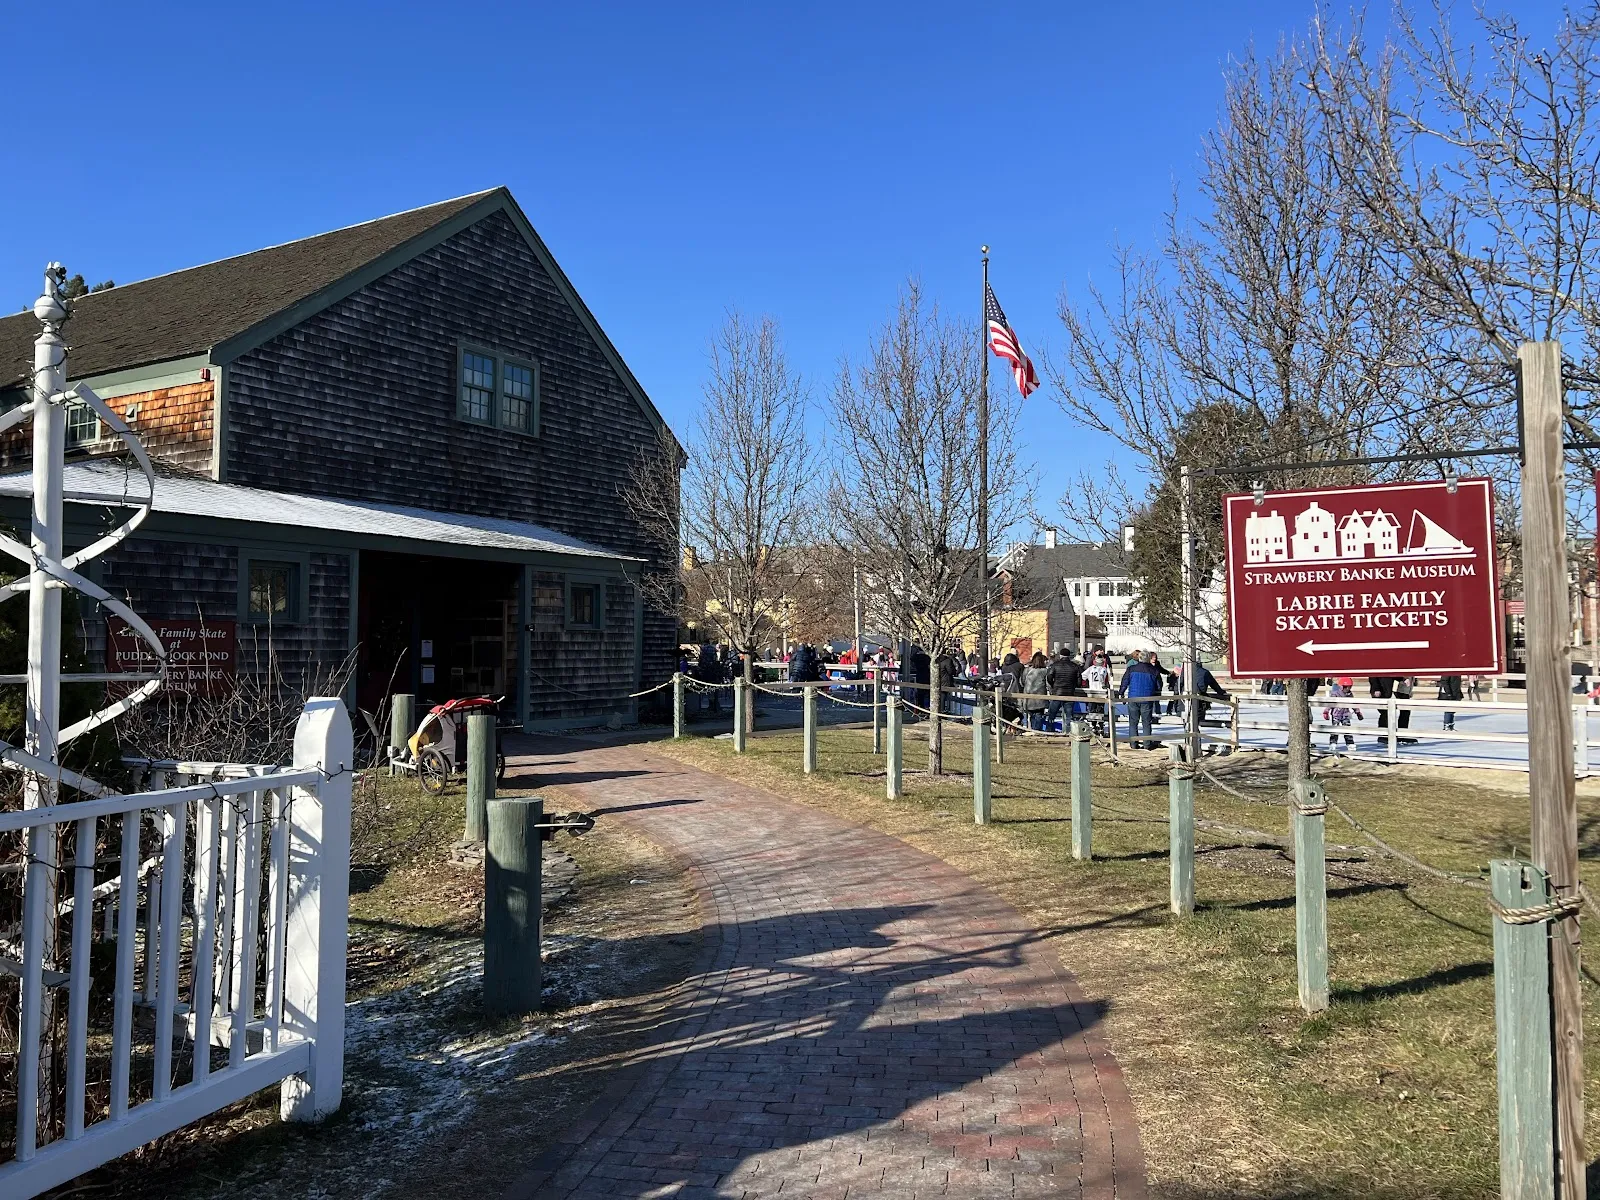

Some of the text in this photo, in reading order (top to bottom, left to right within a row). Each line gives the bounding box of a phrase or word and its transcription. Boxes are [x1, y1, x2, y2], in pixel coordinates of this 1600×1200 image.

[1275, 590, 1446, 612] LABRIE FAMILY
[1275, 610, 1449, 631] SKATE TICKETS
[159, 627, 196, 641] Family
[199, 628, 227, 638] Skate
[169, 639, 181, 649] at
[199, 651, 229, 661] POND
[1091, 671, 1099, 682] 12
